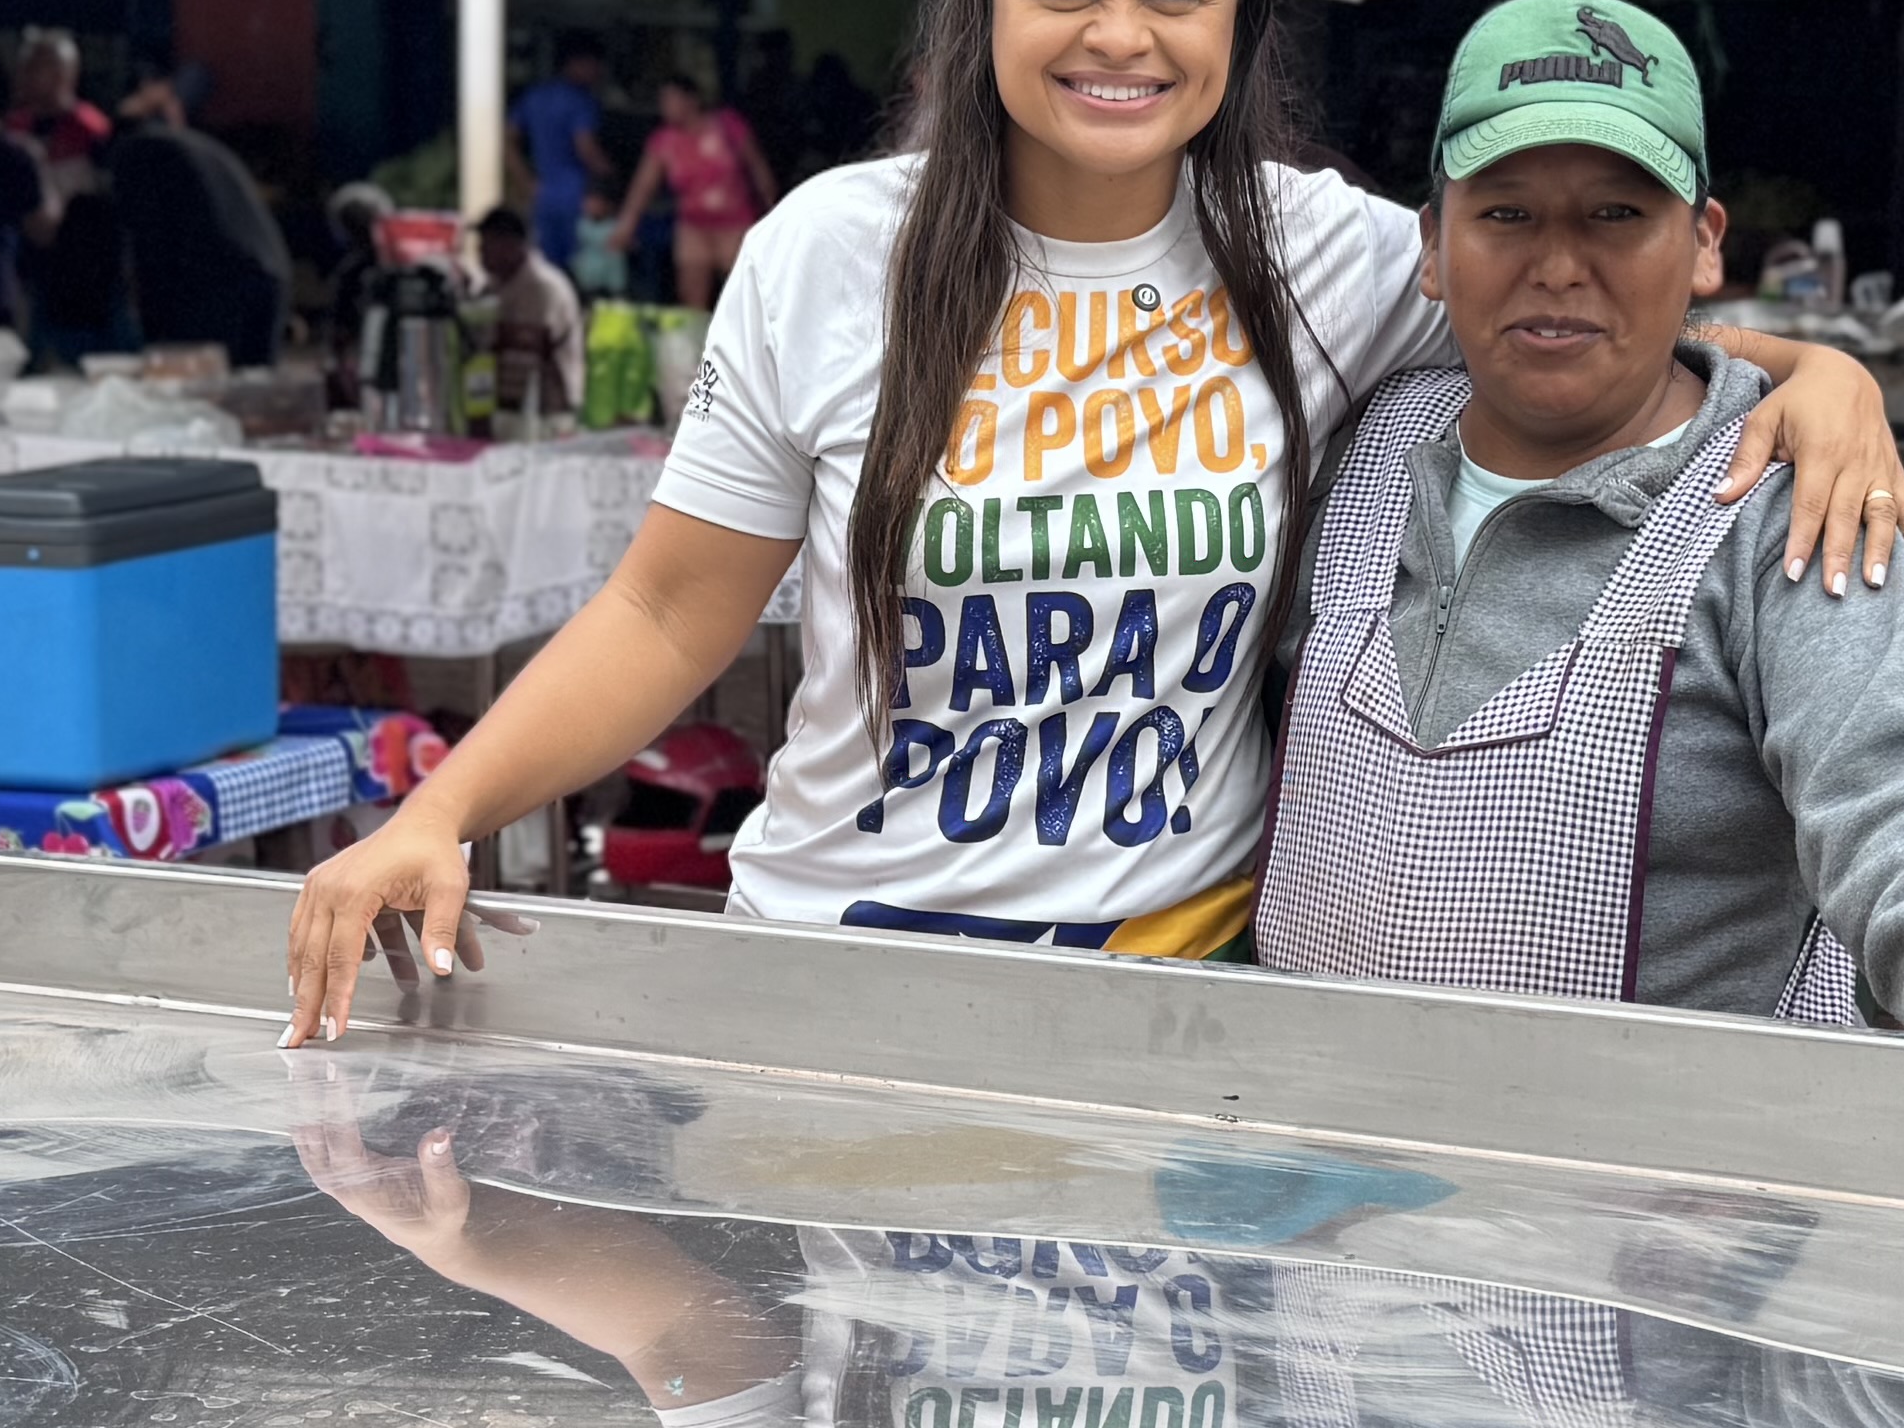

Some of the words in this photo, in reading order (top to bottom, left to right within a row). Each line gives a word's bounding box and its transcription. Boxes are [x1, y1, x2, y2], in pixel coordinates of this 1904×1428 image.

[970, 285, 1256, 391] CURSO
[1023, 375, 1268, 480] POVO,
[891, 588, 1159, 712] PARA
[1181, 582, 1257, 694] O
[856, 704, 1216, 849] POVO!
